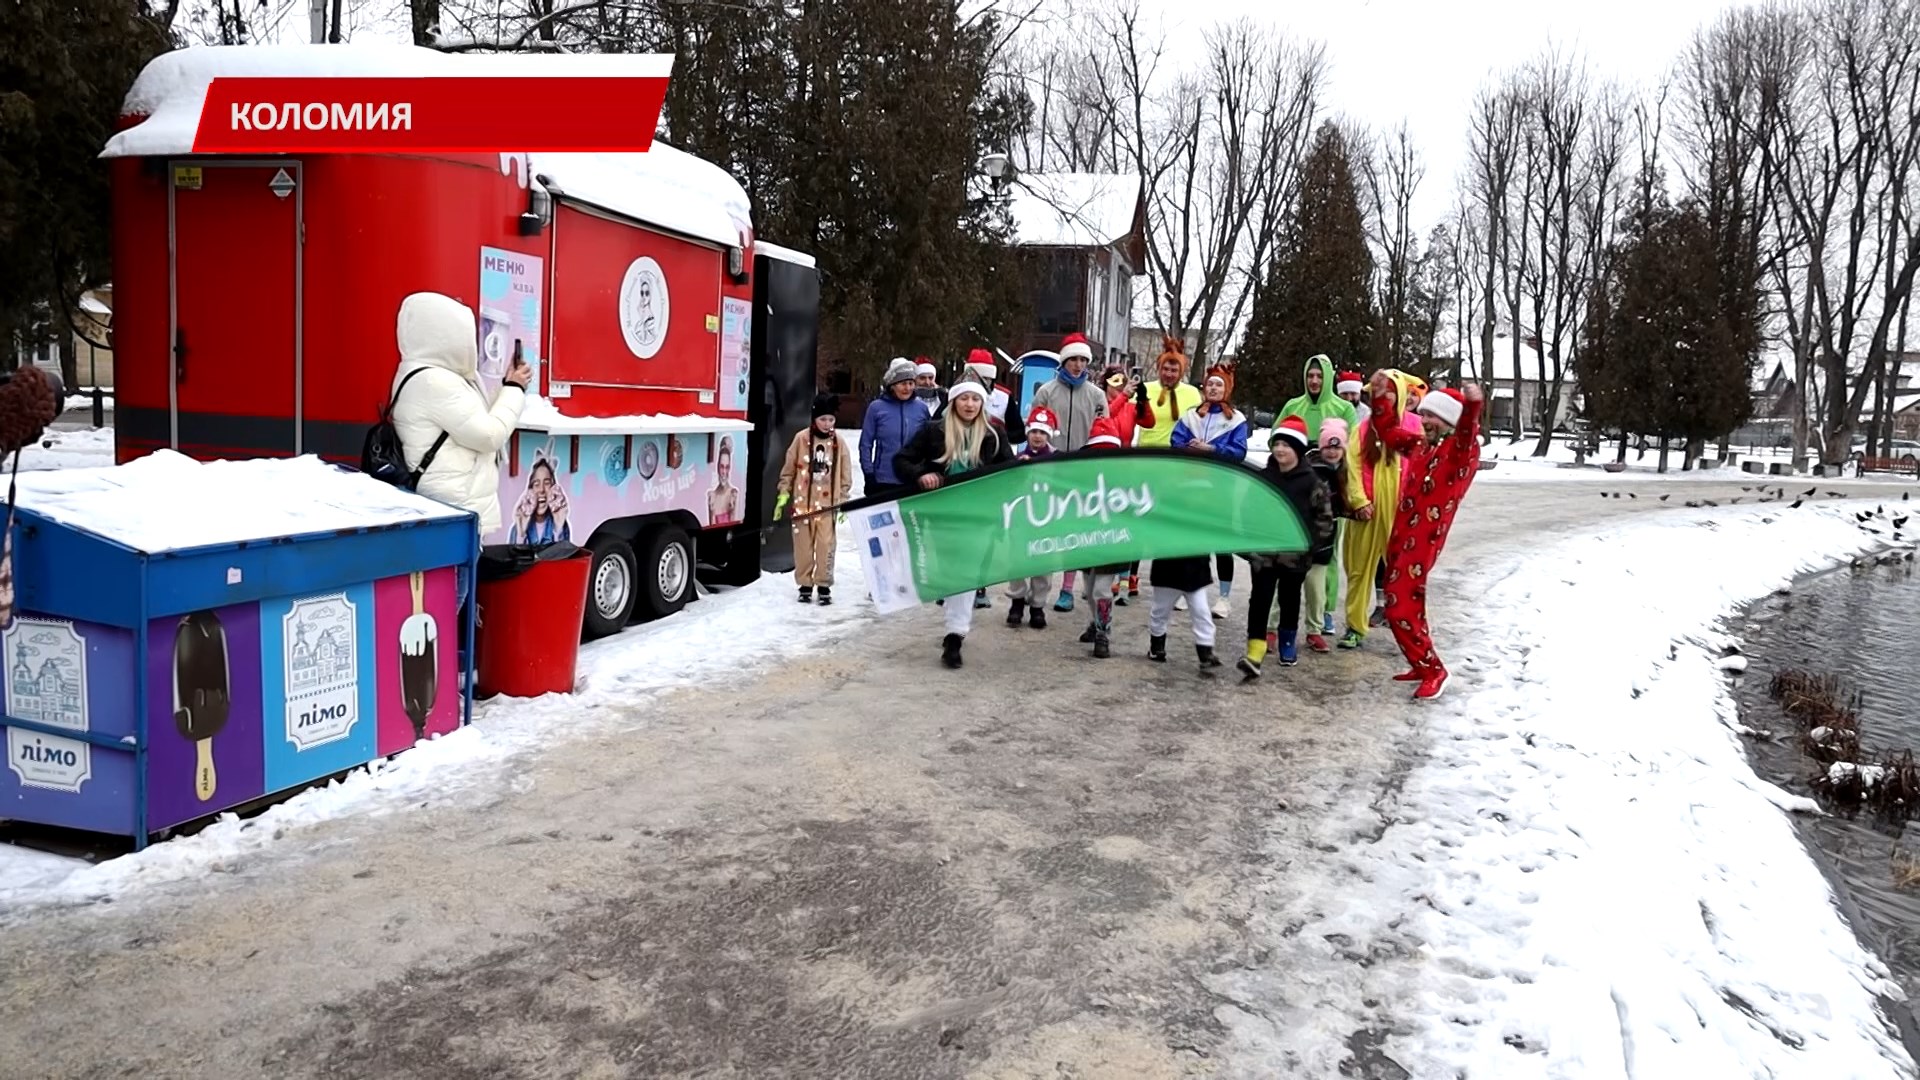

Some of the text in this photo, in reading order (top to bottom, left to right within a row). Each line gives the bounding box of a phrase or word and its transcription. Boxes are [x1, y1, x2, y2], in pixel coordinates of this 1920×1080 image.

[484, 256, 525, 275] МЕНЮ
[725, 303, 745, 314] МЕНЮ
[643, 475, 676, 502] Хочу
[1002, 473, 1154, 528] ründay
[1028, 528, 1130, 556] KOLOMYIA
[298, 703, 347, 728] лімо
[21, 738, 76, 767] лімо
